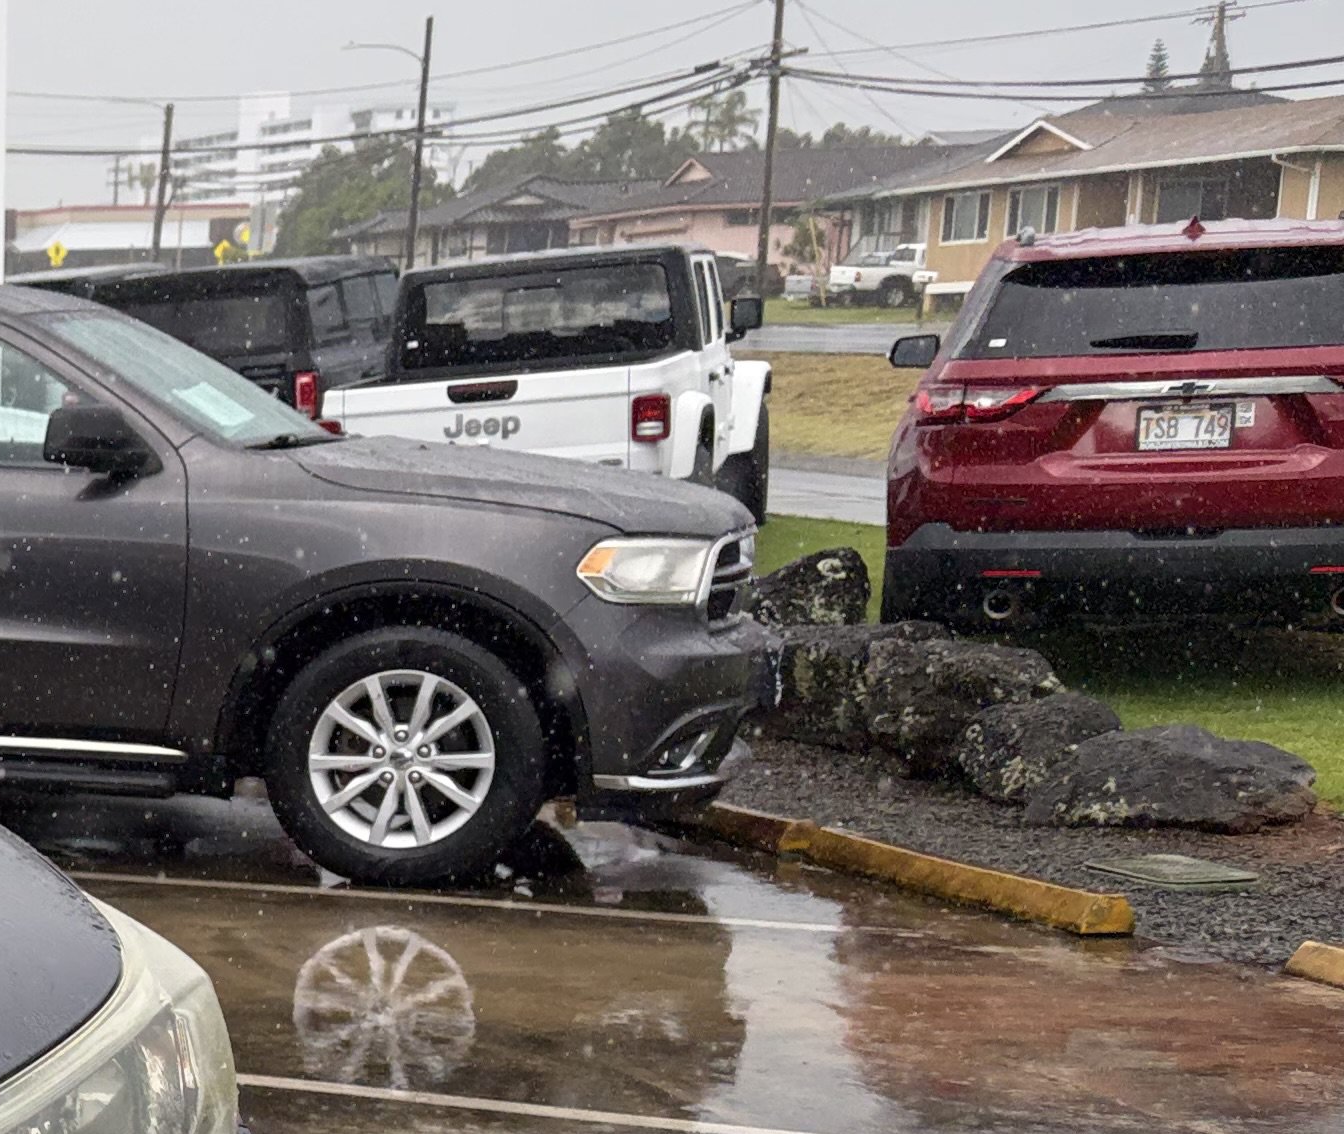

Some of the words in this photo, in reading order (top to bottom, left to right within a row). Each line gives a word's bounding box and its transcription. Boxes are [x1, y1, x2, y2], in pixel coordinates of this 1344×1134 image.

[444, 413, 521, 440] Jeep
[1142, 416, 1179, 440] TSB
[1191, 414, 1229, 439] 749
